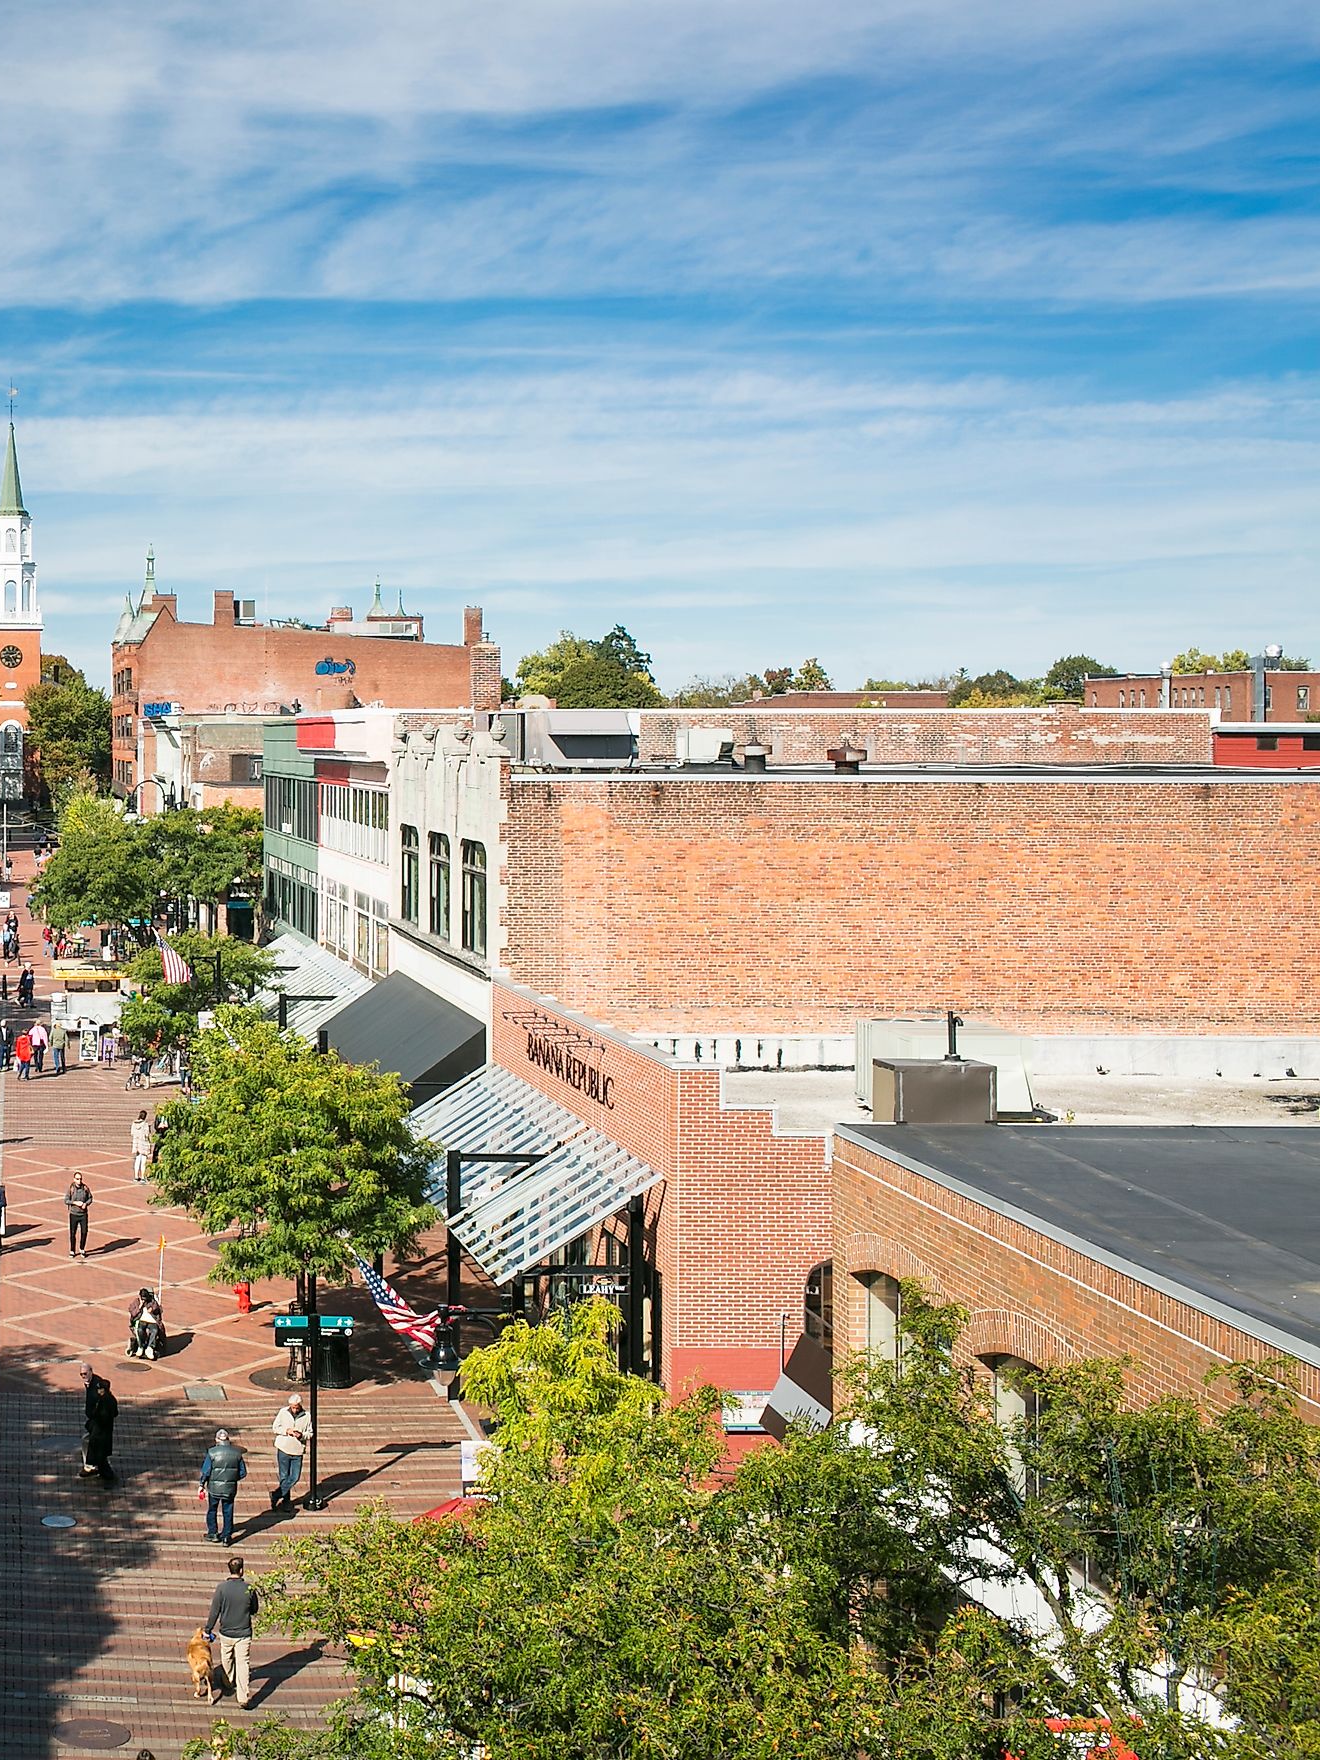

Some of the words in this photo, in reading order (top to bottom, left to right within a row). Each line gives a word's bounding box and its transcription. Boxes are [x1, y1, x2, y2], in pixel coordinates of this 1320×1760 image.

[528, 1033, 565, 1081] BANANA
[566, 1054, 615, 1110] REPUBLIC
[583, 1285, 614, 1294] LEAHY
